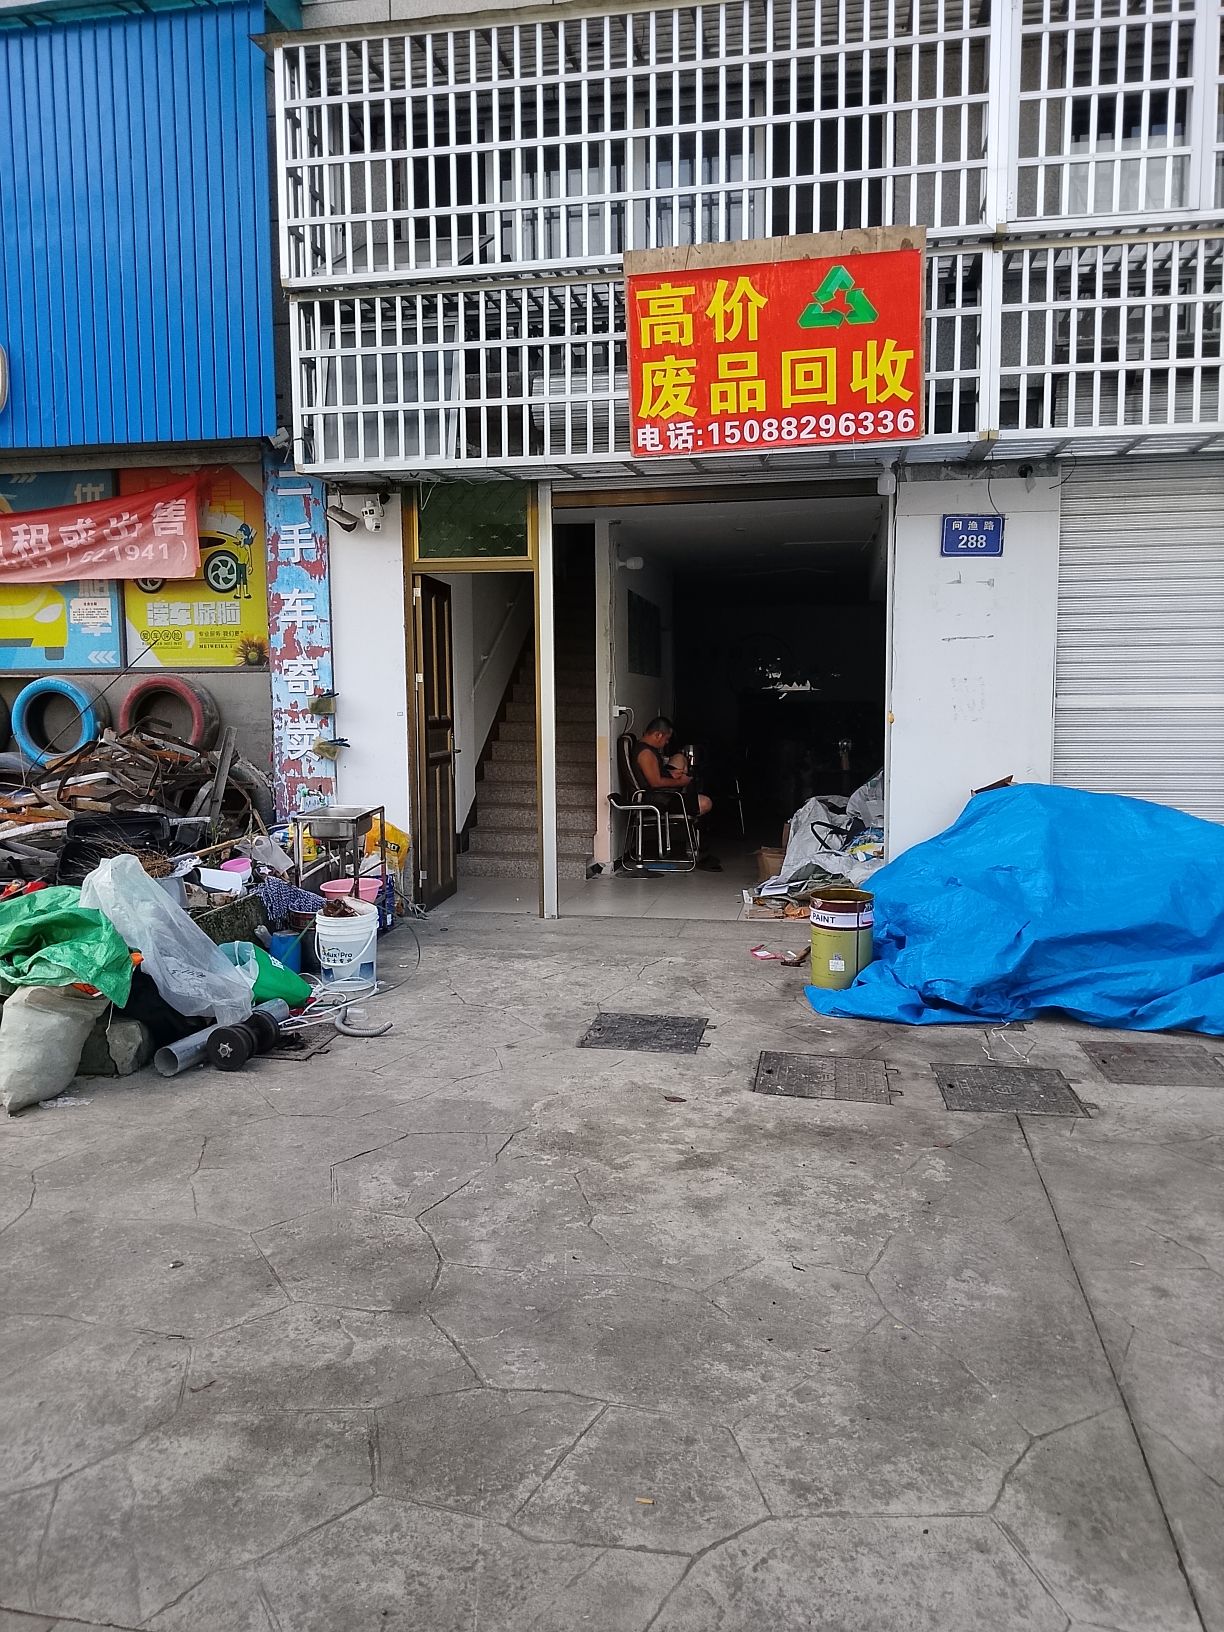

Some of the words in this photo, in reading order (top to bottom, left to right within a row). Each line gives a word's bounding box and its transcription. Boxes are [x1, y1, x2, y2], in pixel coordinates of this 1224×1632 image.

[636, 276, 769, 349] 高价
[638, 339, 914, 420] 废品回收
[0, 498, 187, 561] 租或出售
[957, 534, 987, 549] 288
[276, 470, 321, 762] 二手车寄卖
[812, 912, 837, 924] PAINT
